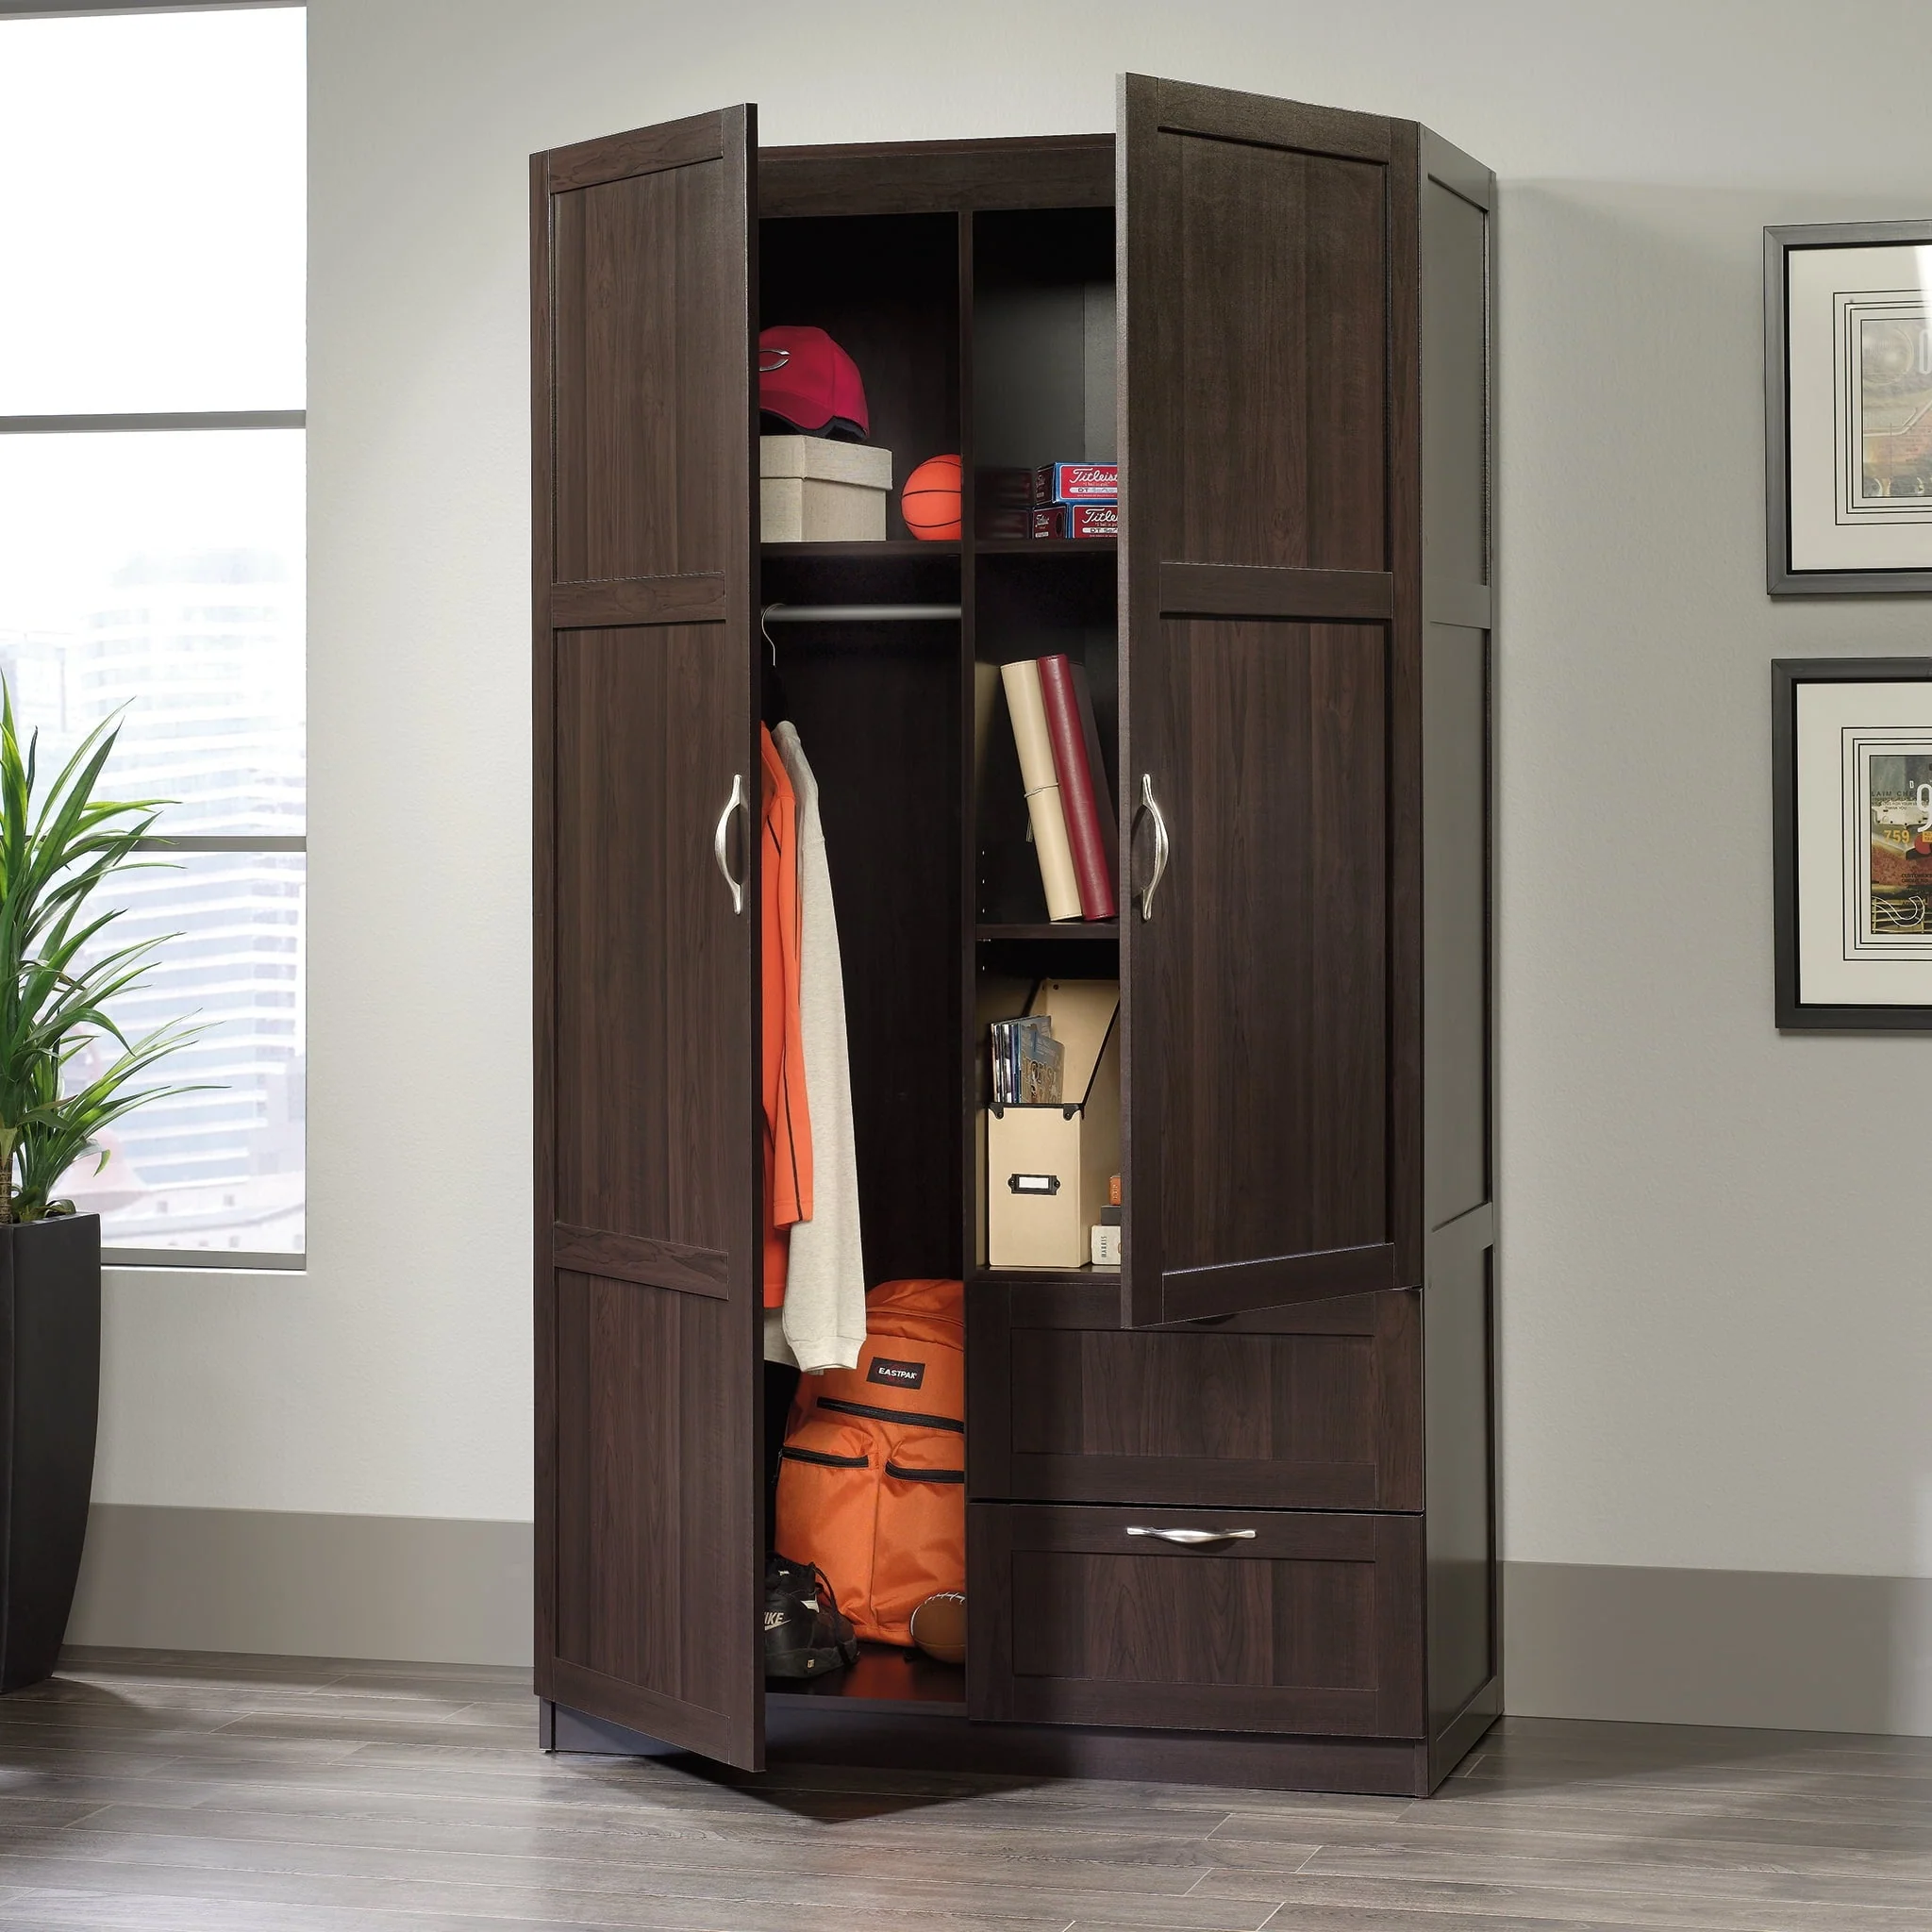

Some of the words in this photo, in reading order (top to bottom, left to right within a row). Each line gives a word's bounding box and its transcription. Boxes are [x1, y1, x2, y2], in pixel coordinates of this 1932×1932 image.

[1081, 508, 1118, 524] Title
[1884, 830, 1910, 843] 759
[878, 1367, 916, 1379] EASTPAK
[764, 1611, 784, 1624] IKE
